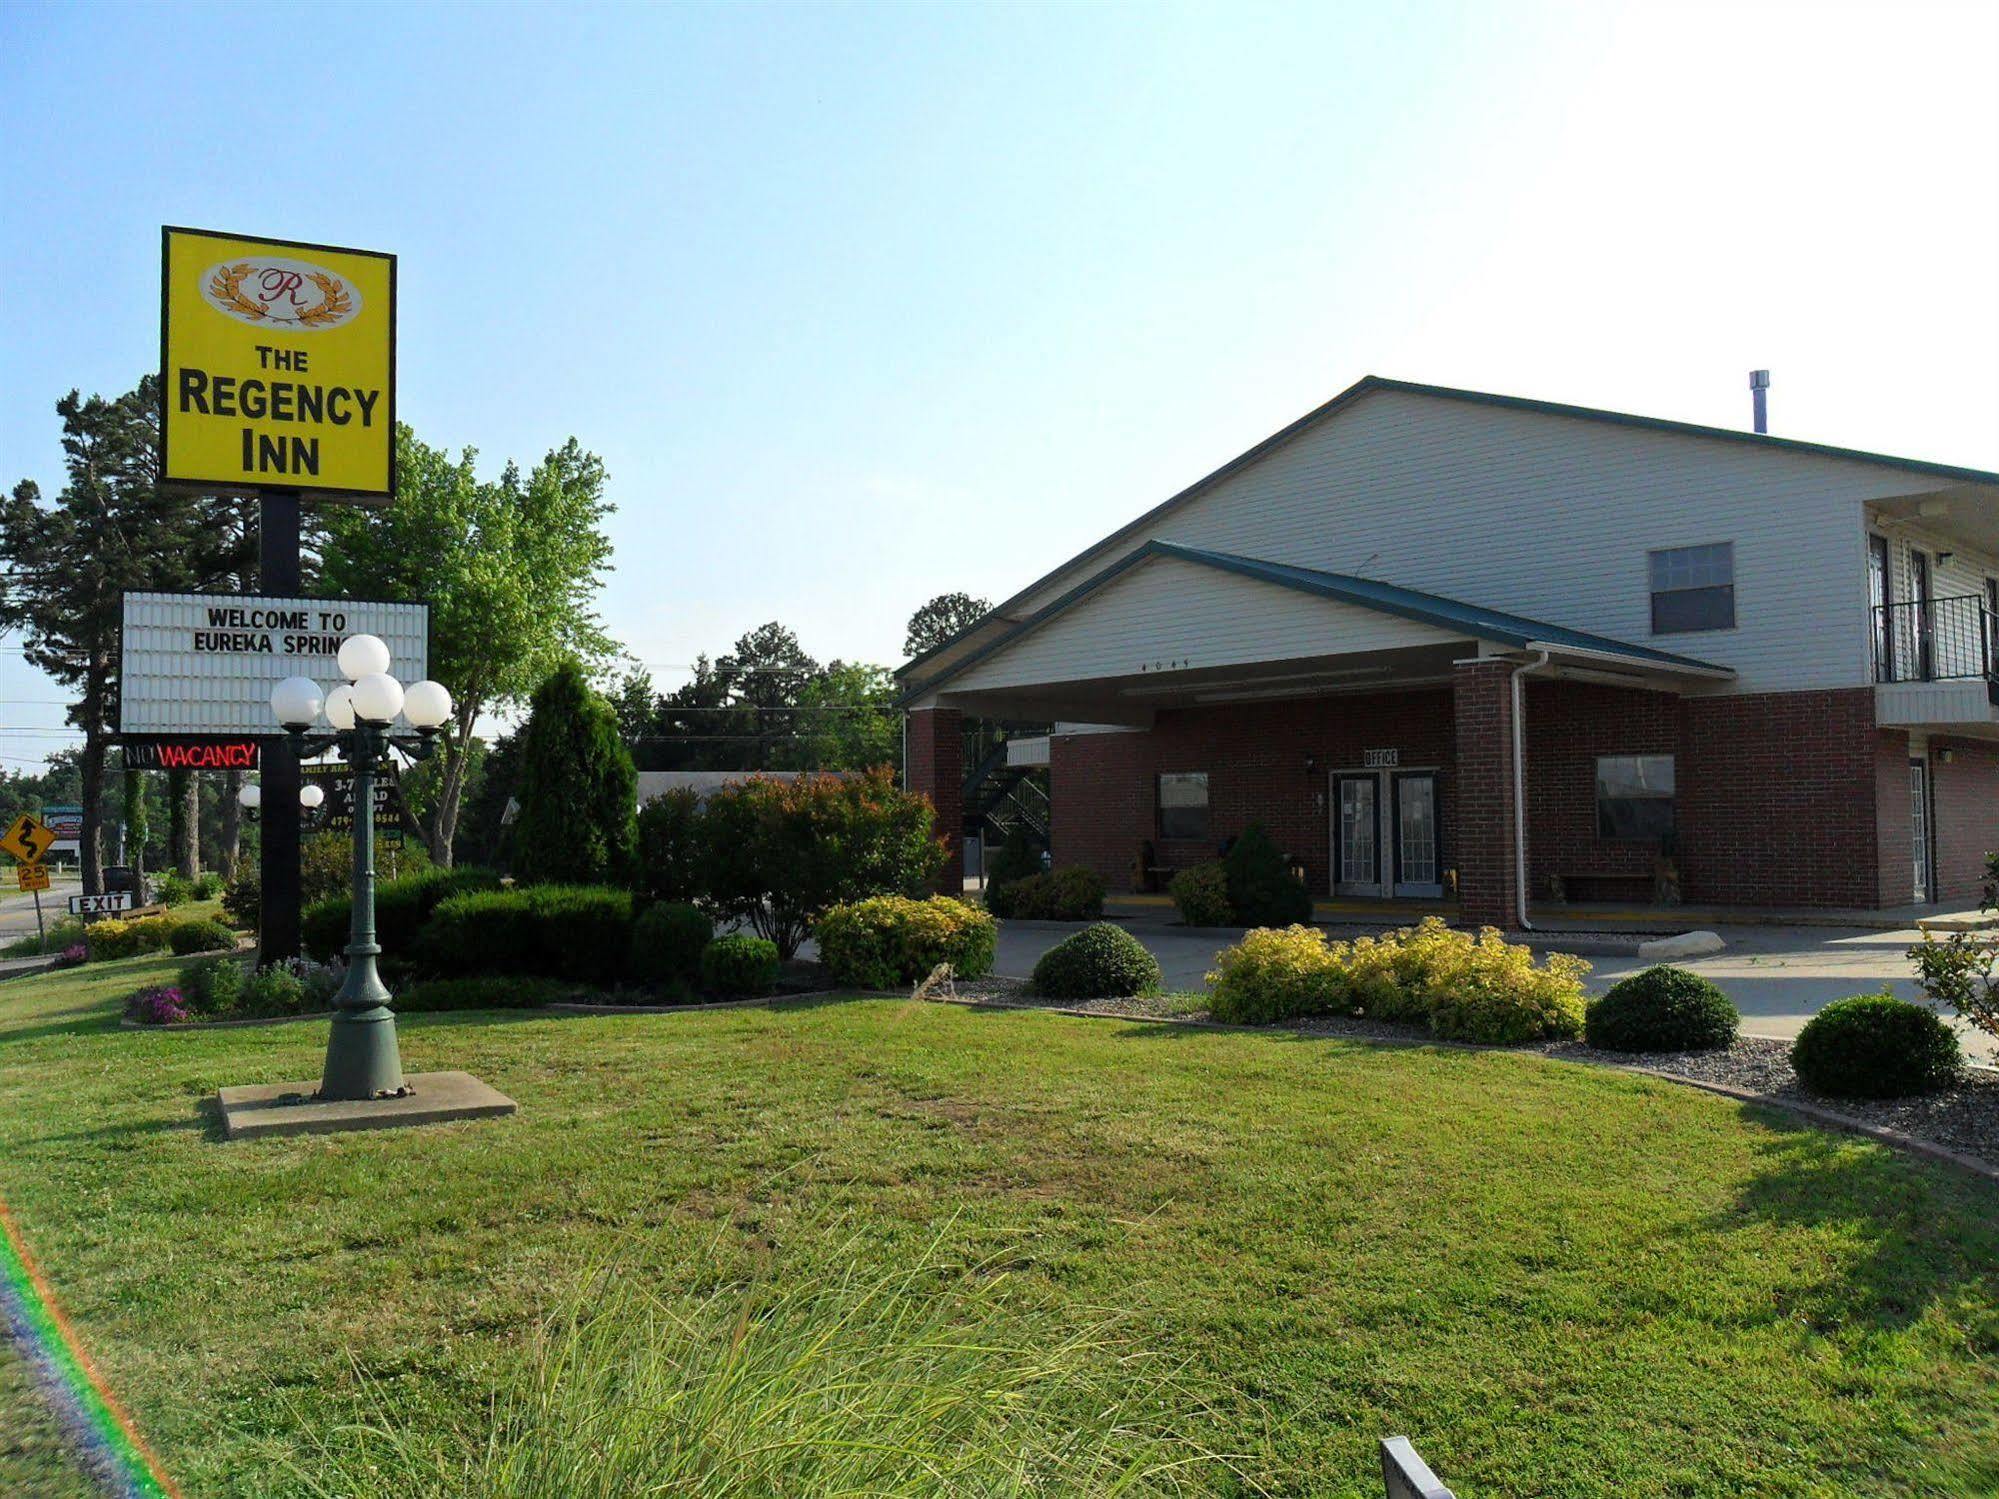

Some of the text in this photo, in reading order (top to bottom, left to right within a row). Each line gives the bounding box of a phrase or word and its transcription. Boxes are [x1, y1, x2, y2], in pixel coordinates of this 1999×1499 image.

[258, 268, 307, 306] R
[255, 345, 308, 373] THE
[179, 368, 380, 427] REGENCY
[242, 428, 319, 476] INN
[208, 608, 346, 631] WELCOME TO
[194, 632, 272, 653] EUREKA
[125, 744, 154, 767] NO
[1366, 750, 1396, 765] OFFICE
[22, 866, 45, 880] 25
[79, 895, 125, 912] EXIT
